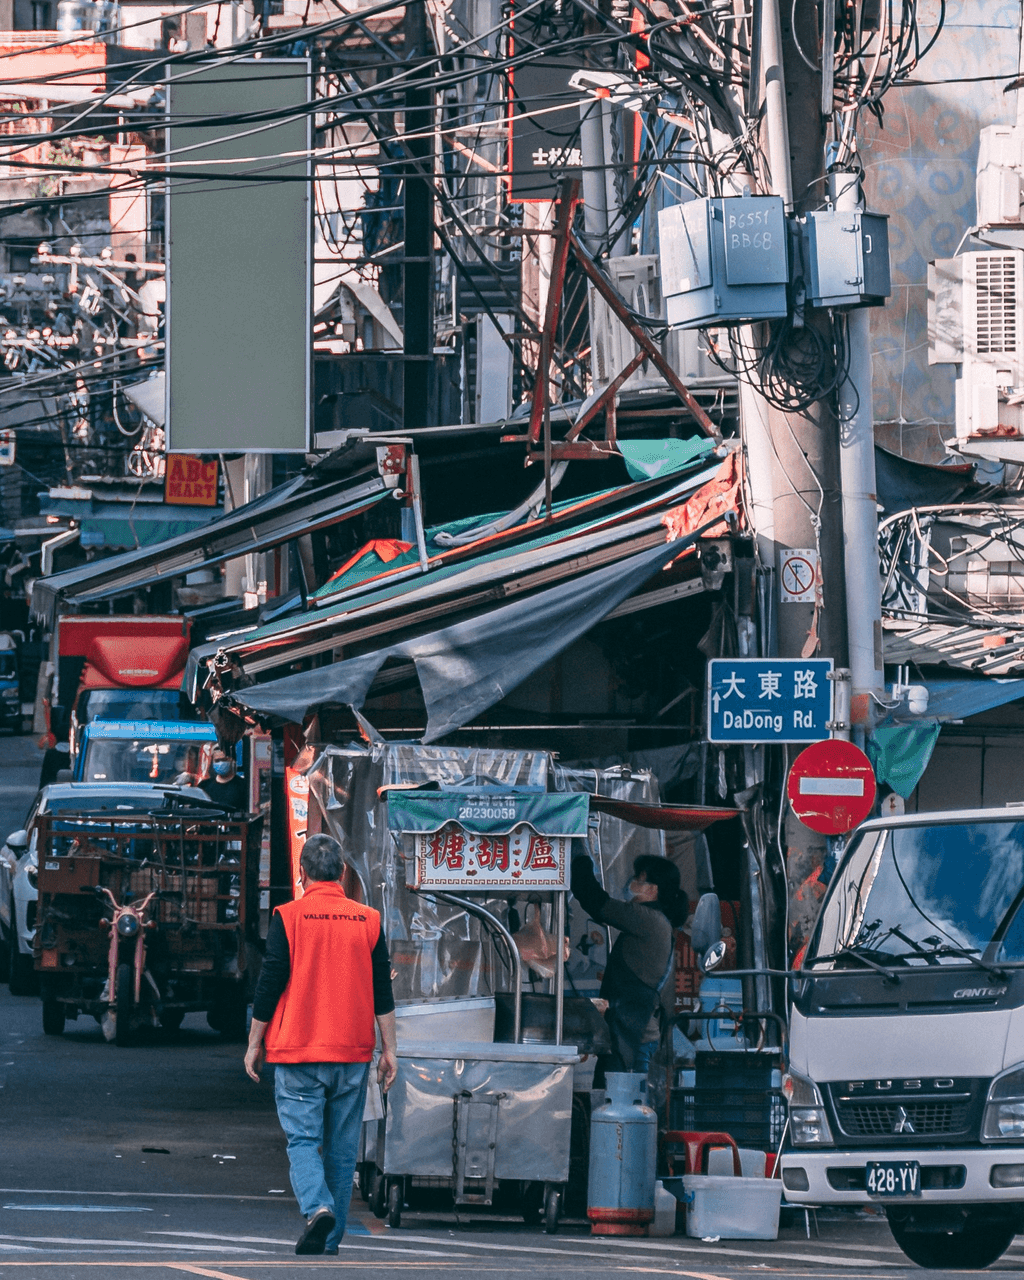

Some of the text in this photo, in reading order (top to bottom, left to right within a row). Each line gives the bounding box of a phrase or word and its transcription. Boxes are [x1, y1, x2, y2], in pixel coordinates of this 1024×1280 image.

[168, 481, 215, 499] MART
[722, 669, 818, 700] 大東路
[723, 710, 816, 732] DaDong Rd.
[332, 914, 358, 922] STYLE
[953, 985, 1008, 999] CANTER
[849, 1078, 955, 1092] FUSO
